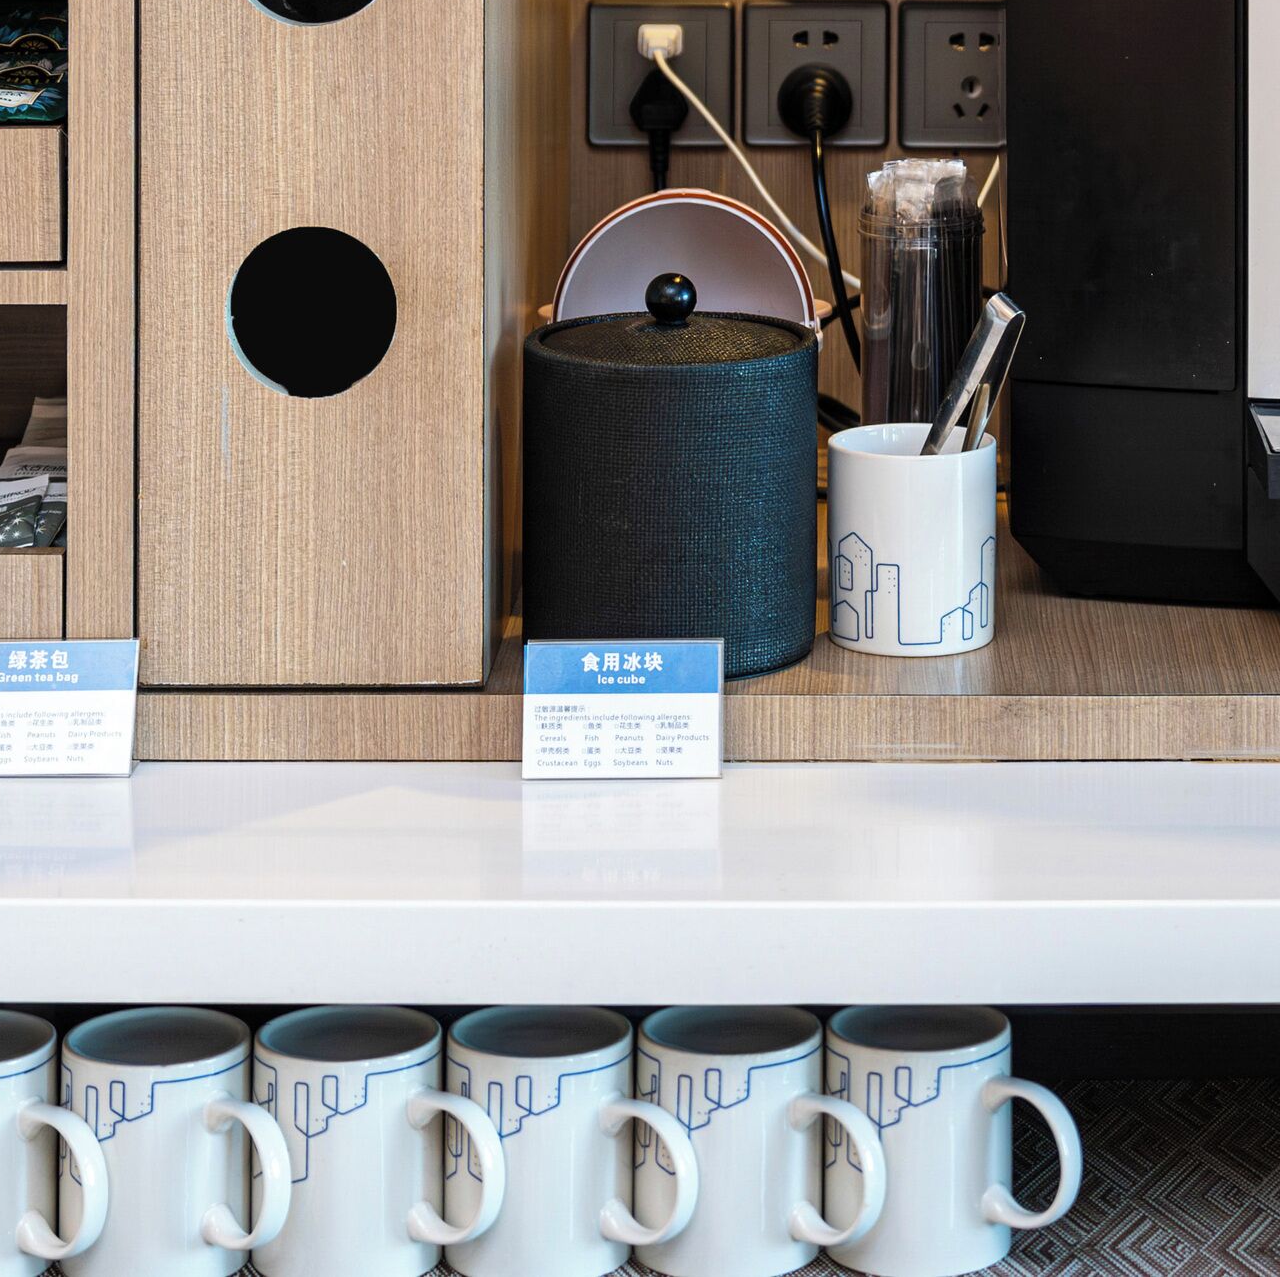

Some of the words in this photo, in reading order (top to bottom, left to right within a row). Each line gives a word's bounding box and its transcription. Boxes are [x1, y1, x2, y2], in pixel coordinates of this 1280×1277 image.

[8, 650, 69, 670] 绿茶包
[581, 652, 664, 672] 食用冰块
[35, 672, 53, 683] tea
[56, 672, 79, 683] bag
[597, 675, 614, 684] Ice
[617, 675, 646, 684] cube
[534, 714, 547, 722] The
[549, 714, 590, 722] ingredients
[592, 714, 619, 722] include
[620, 714, 655, 722] following
